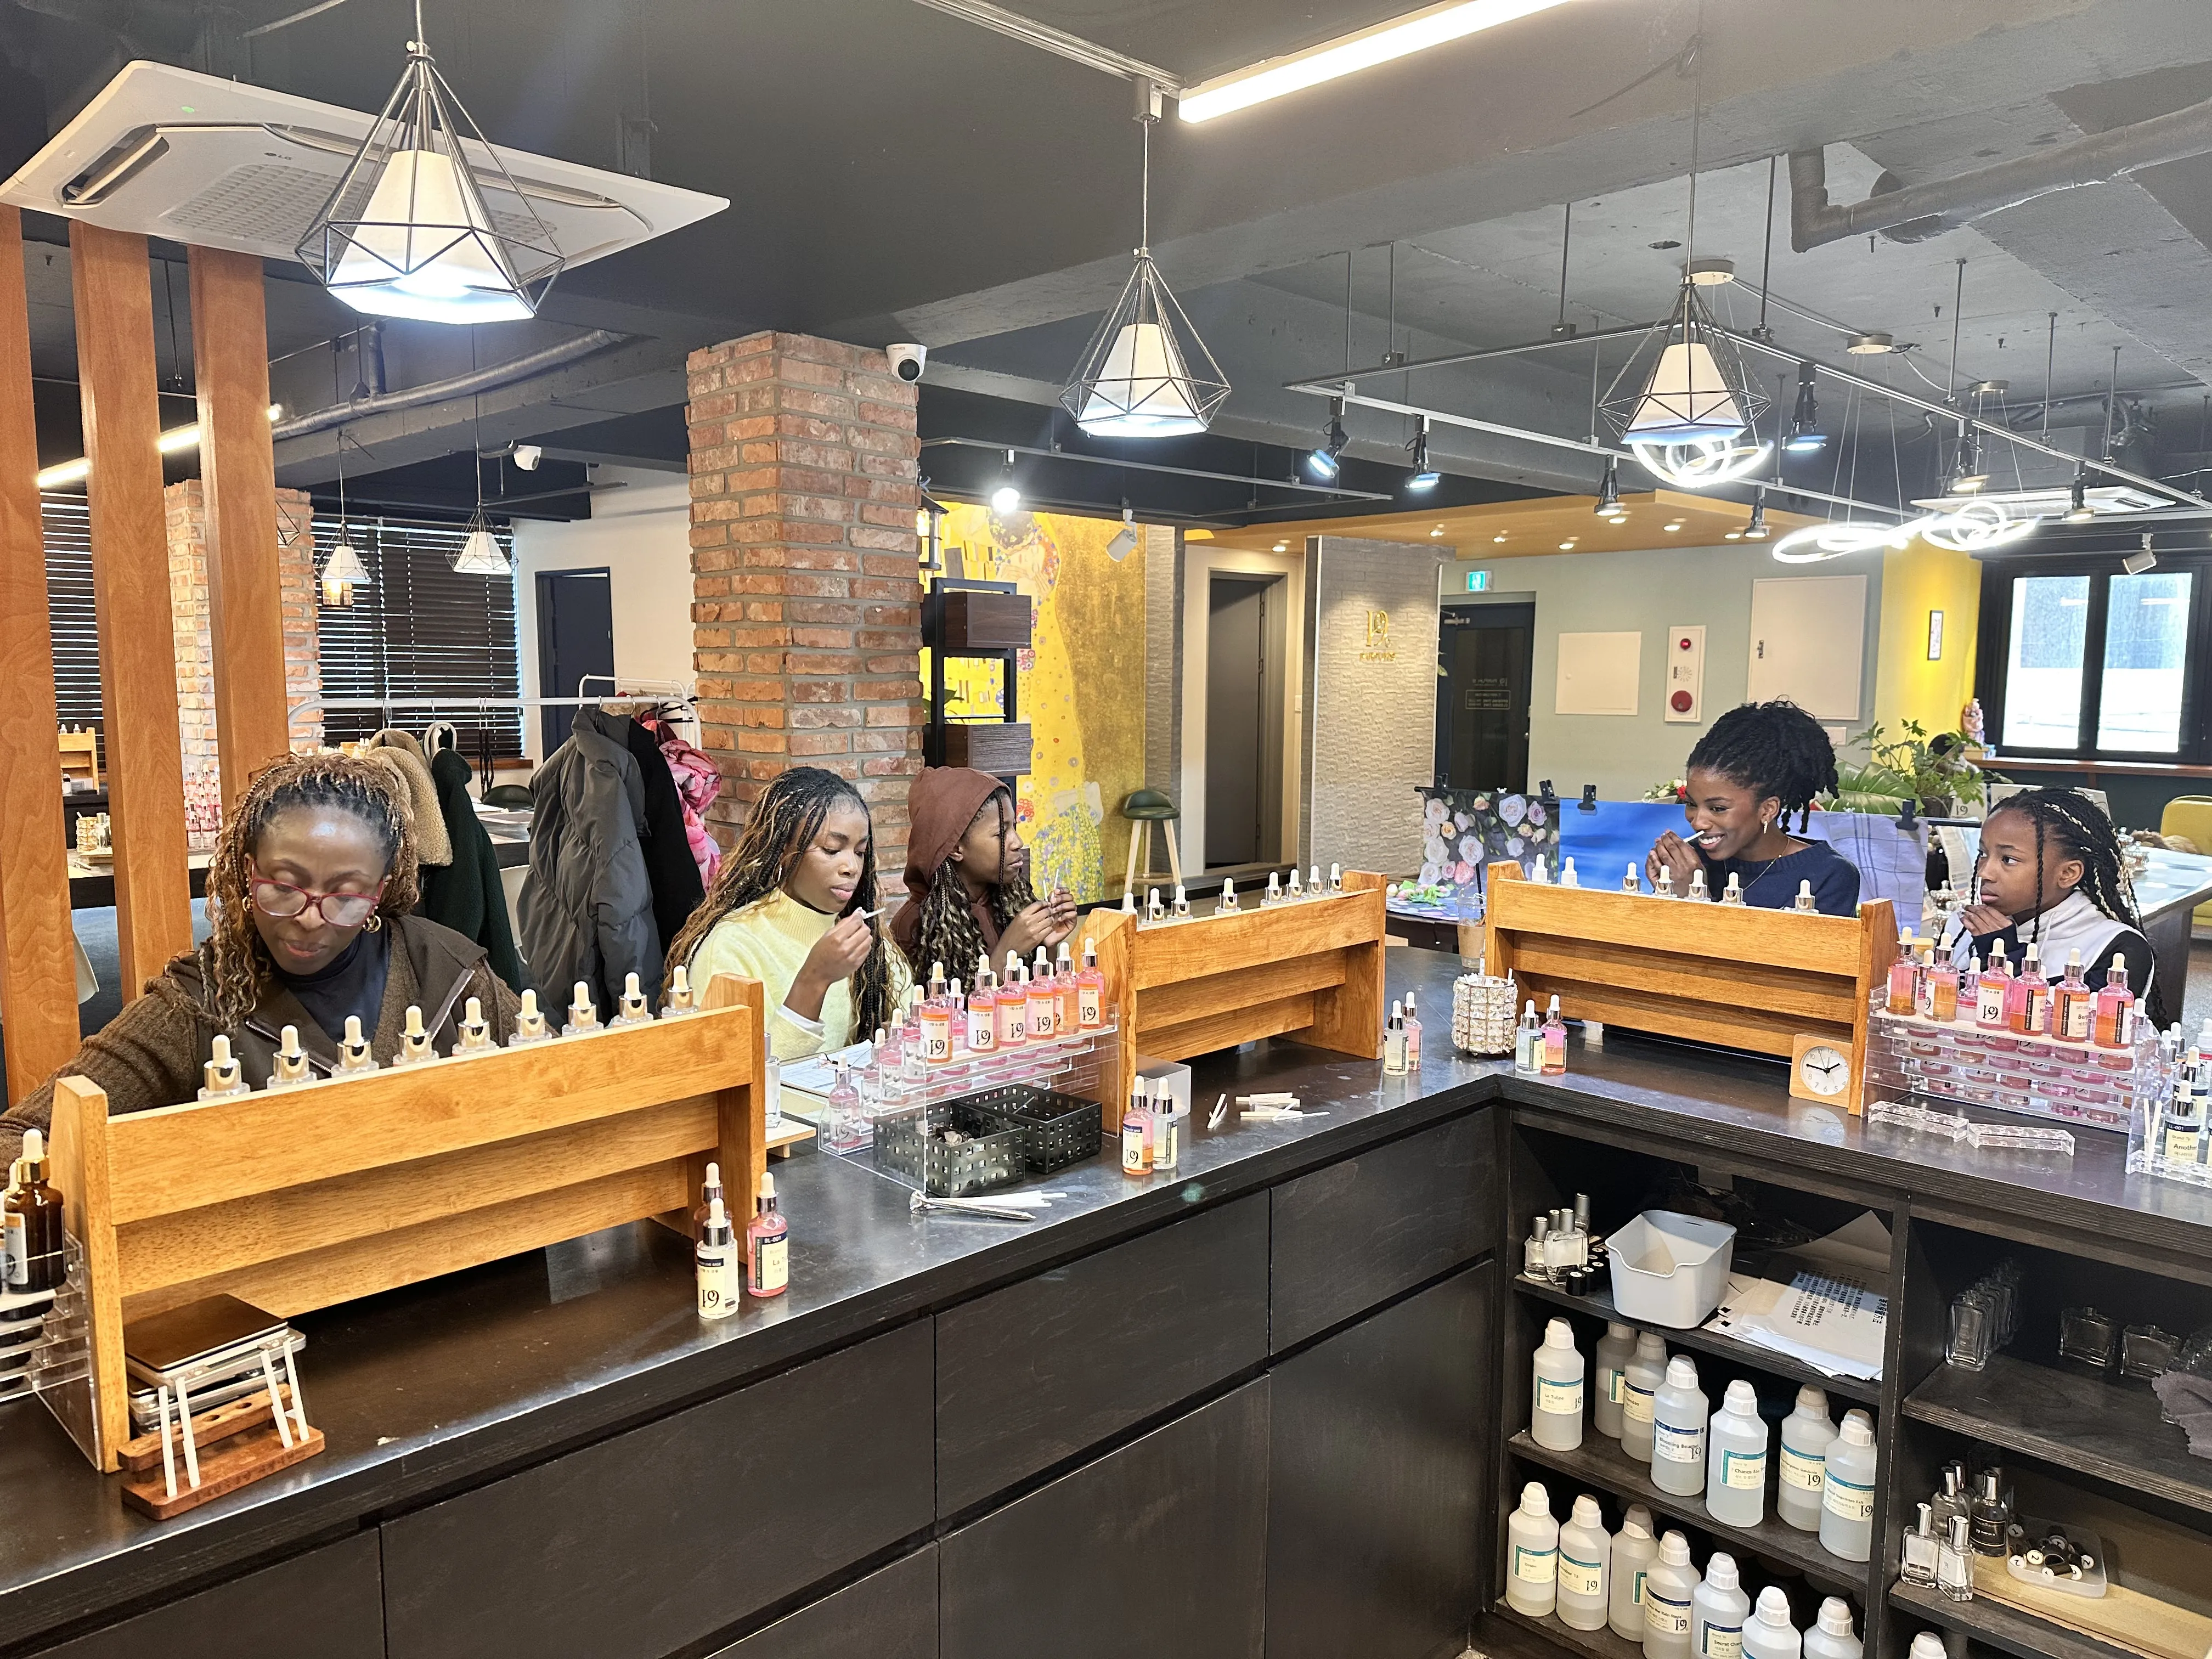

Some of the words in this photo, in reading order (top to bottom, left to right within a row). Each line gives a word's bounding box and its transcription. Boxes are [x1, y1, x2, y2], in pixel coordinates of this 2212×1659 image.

[1956, 805, 1968, 815] 19
[1082, 1007, 1096, 1020] 19
[1983, 1005, 1998, 1019] 19
[1011, 1023, 1024, 1038] 19
[1037, 1017, 1051, 1031] 19
[976, 1030, 990, 1045] 19
[929, 1040, 945, 1055] 19
[1126, 1149, 1138, 1164] 19
[702, 1289, 719, 1308] 19
[1575, 1396, 1582, 1409] 19
[1808, 1474, 1820, 1487] 19
[1860, 1505, 1873, 1517] 19
[1587, 1581, 1598, 1591] 19
[1675, 1620, 1687, 1631] 19
